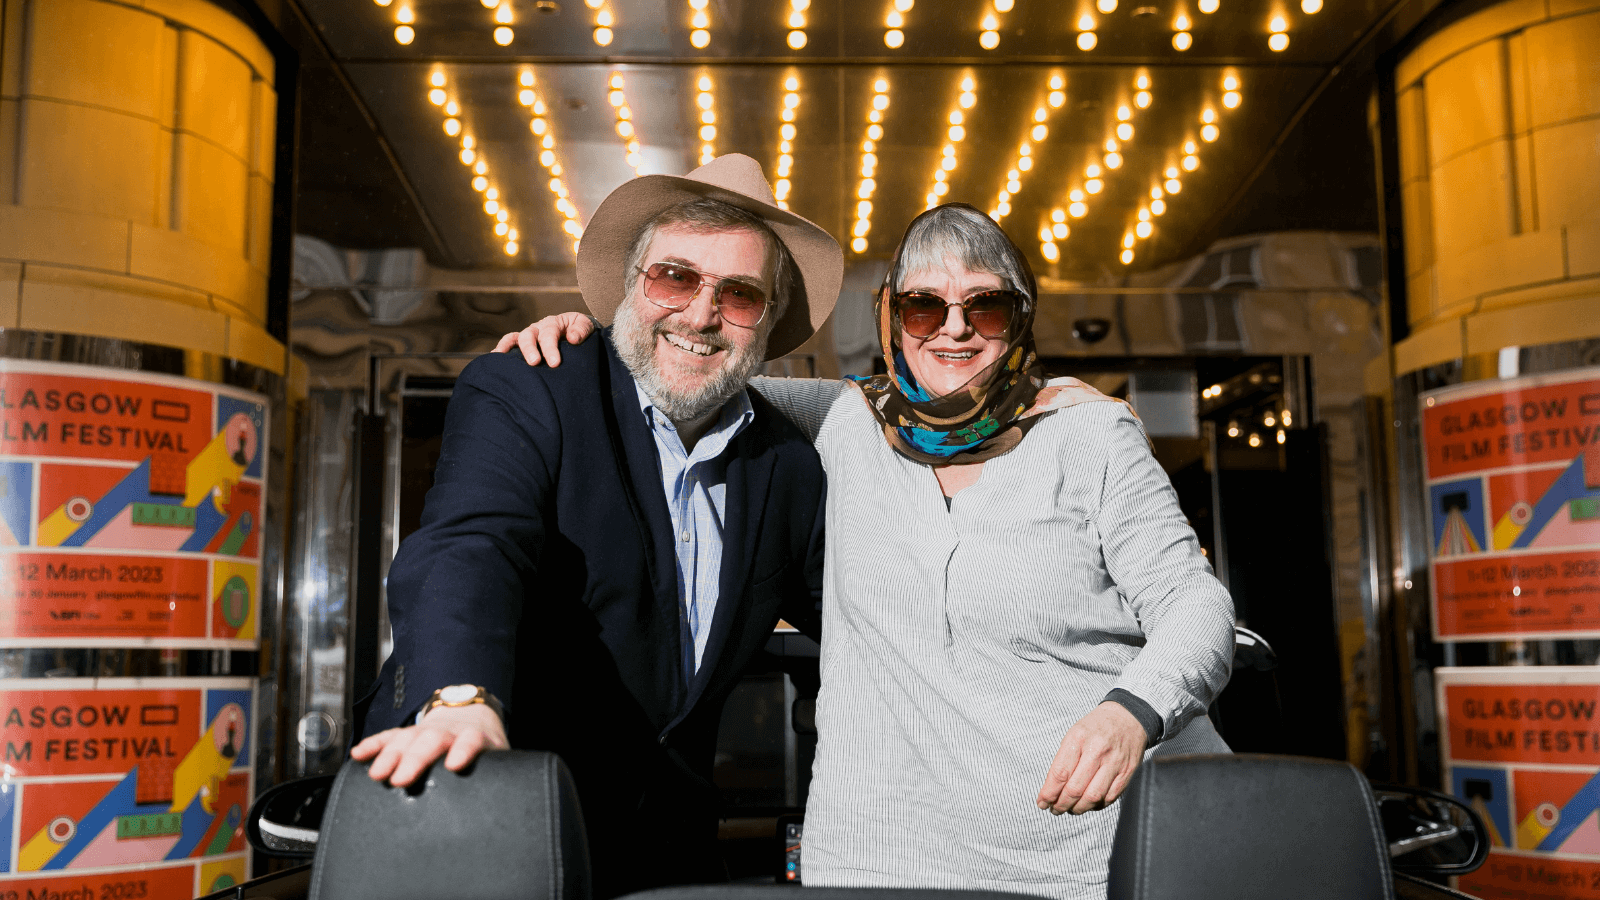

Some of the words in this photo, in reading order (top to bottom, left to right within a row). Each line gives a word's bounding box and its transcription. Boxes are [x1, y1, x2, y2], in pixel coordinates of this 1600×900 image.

[1442, 398, 1568, 436] GLASGOW
[60, 423, 189, 453] FESTIVAL
[1442, 440, 1491, 464] FILM
[46, 563, 111, 582] March
[117, 565, 164, 583] 2023
[1501, 562, 1558, 581] March
[1463, 699, 1596, 720] GLASGOW
[45, 737, 176, 761] FESTIVAL
[1464, 729, 1516, 751] FILM
[100, 880, 148, 899] 2023
